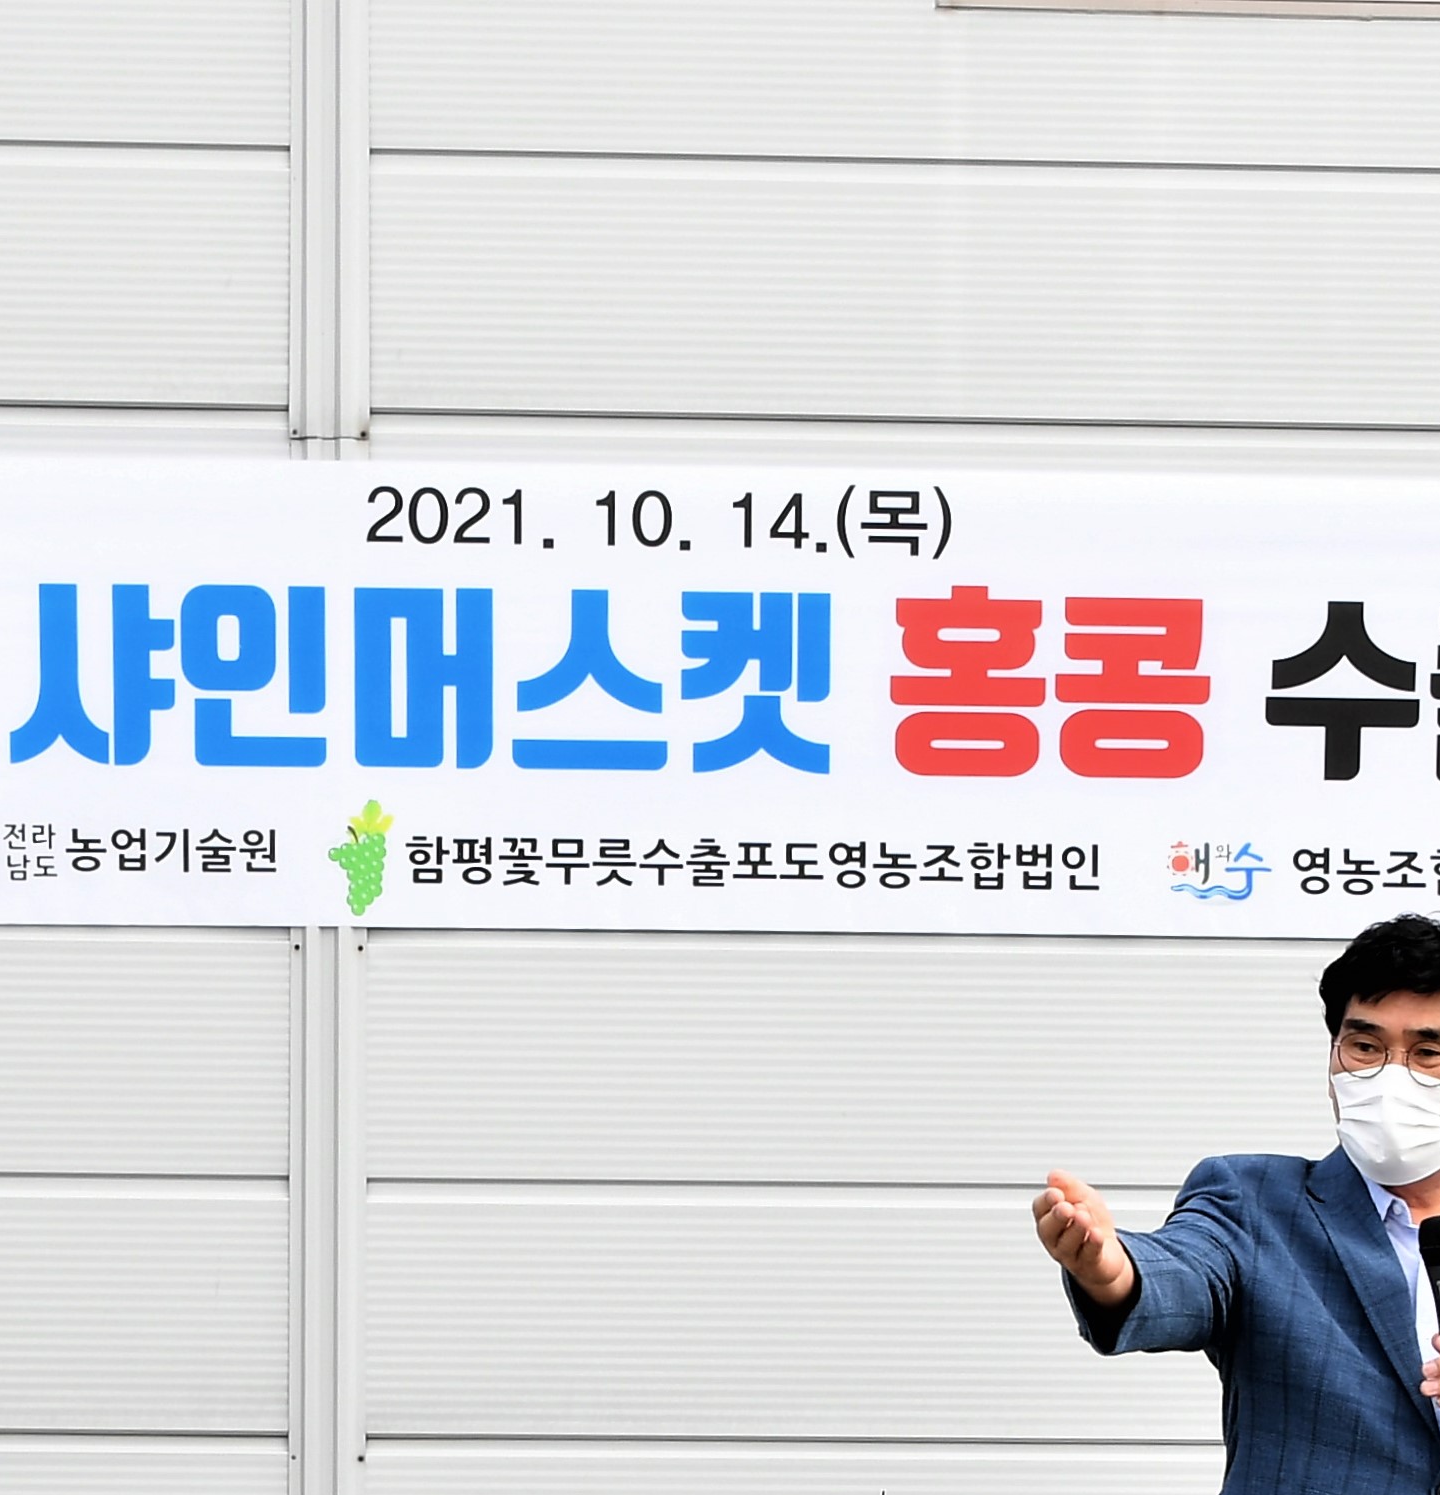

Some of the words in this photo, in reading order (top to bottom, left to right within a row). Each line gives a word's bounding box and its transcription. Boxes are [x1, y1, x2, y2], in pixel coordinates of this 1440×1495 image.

[365, 484, 555, 550] 2021.
[594, 489, 692, 552] 10.
[731, 483, 953, 561] 14.(목)
[9, 582, 832, 776] 샤인머스켓
[890, 584, 1212, 780] 홍콩
[2, 822, 57, 851] 전라
[64, 827, 278, 874] 농업기술원
[6, 853, 59, 882] 남도
[404, 834, 1101, 892] 함평꽃무릇수출포도영농조합법인
